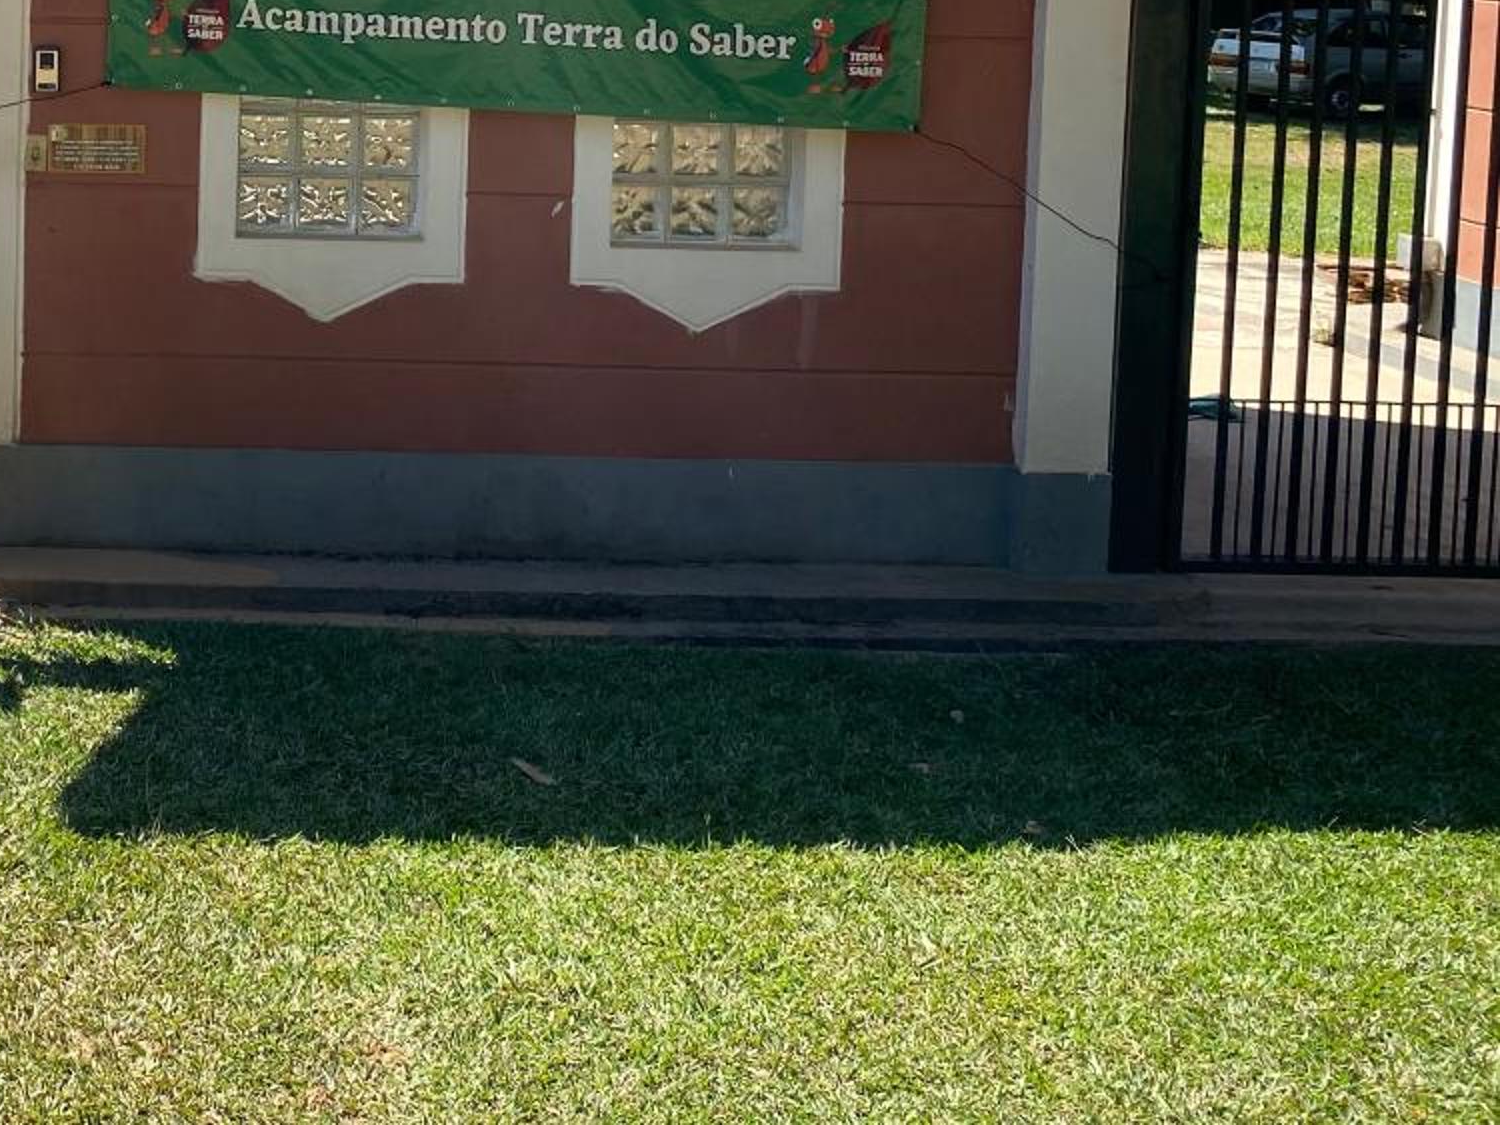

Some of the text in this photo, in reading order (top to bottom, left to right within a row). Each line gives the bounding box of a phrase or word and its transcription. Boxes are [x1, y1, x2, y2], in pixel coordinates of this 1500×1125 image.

[187, 14, 224, 26] TERRA
[187, 28, 223, 40] SABER
[236, 0, 797, 60] Acampamento Terra do Saber
[849, 52, 884, 62] TERRA
[848, 66, 883, 77] SABER
